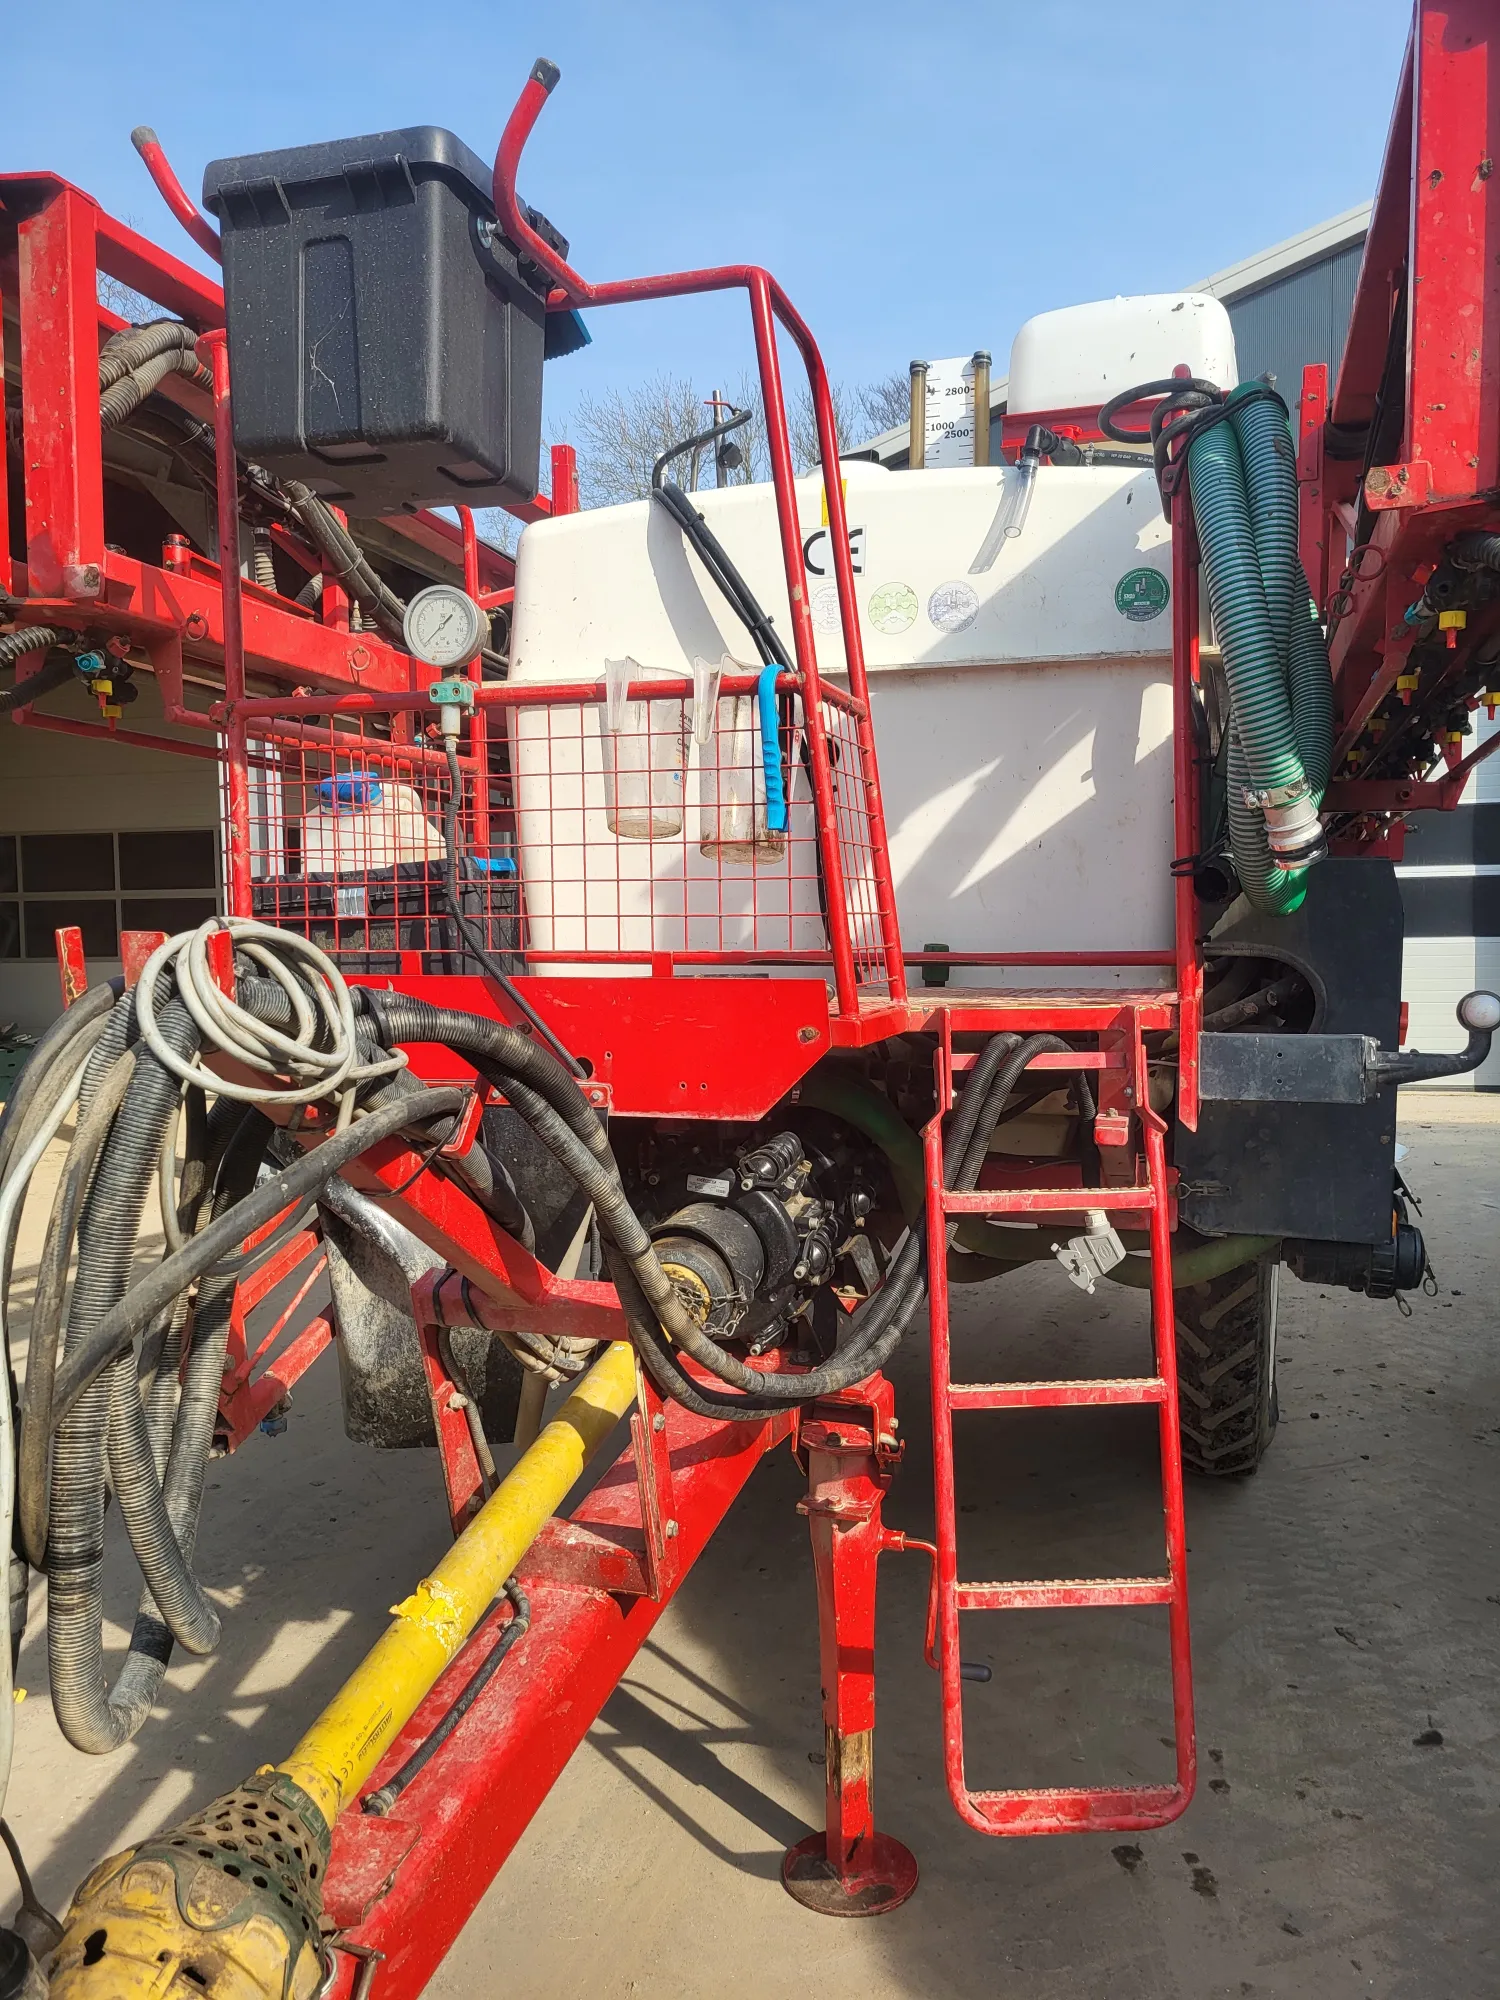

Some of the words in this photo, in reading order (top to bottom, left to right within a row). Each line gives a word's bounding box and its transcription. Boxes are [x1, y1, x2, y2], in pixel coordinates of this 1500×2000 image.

[945, 386, 970, 396] 2800
[931, 422, 954, 432] 1000
[944, 429, 969, 439] 2500
[340, 1760, 354, 1778] CE
